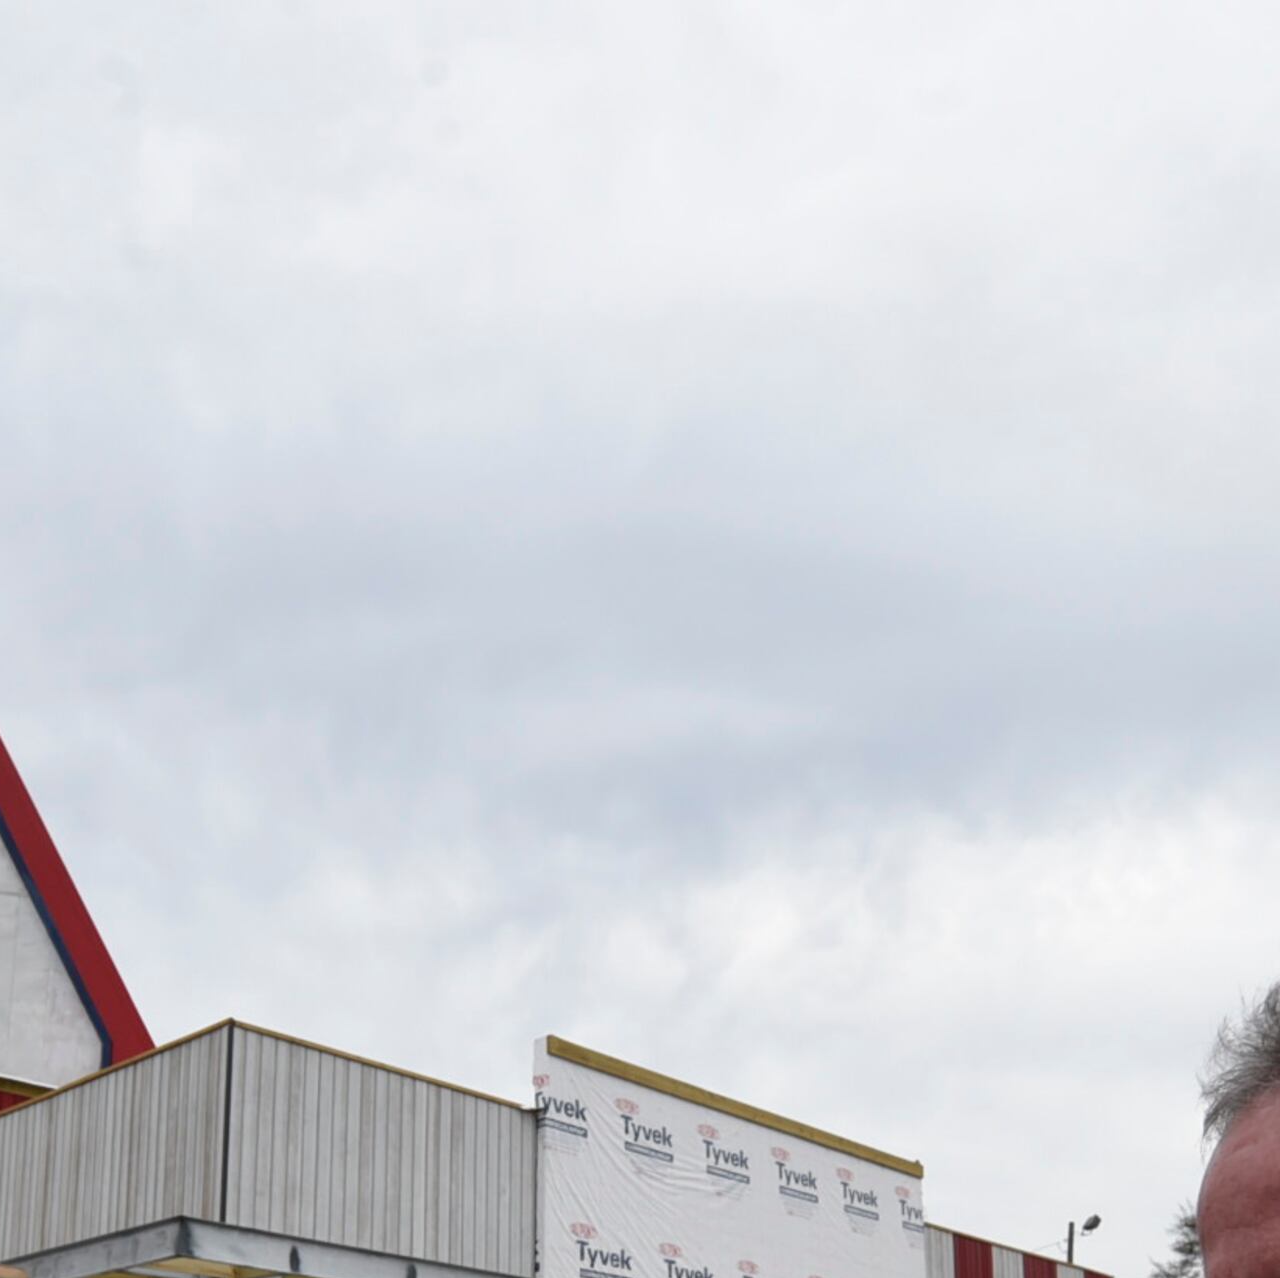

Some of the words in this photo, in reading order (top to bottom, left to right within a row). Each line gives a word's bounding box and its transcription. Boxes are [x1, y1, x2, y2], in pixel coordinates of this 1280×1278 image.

[621, 1114, 673, 1147] Tyvek
[703, 1139, 749, 1169] Tyvek
[776, 1161, 818, 1190] Tyvek
[841, 1181, 878, 1207] Tyvek
[899, 1199, 923, 1221] Tyv
[576, 1239, 632, 1271] Tyvek
